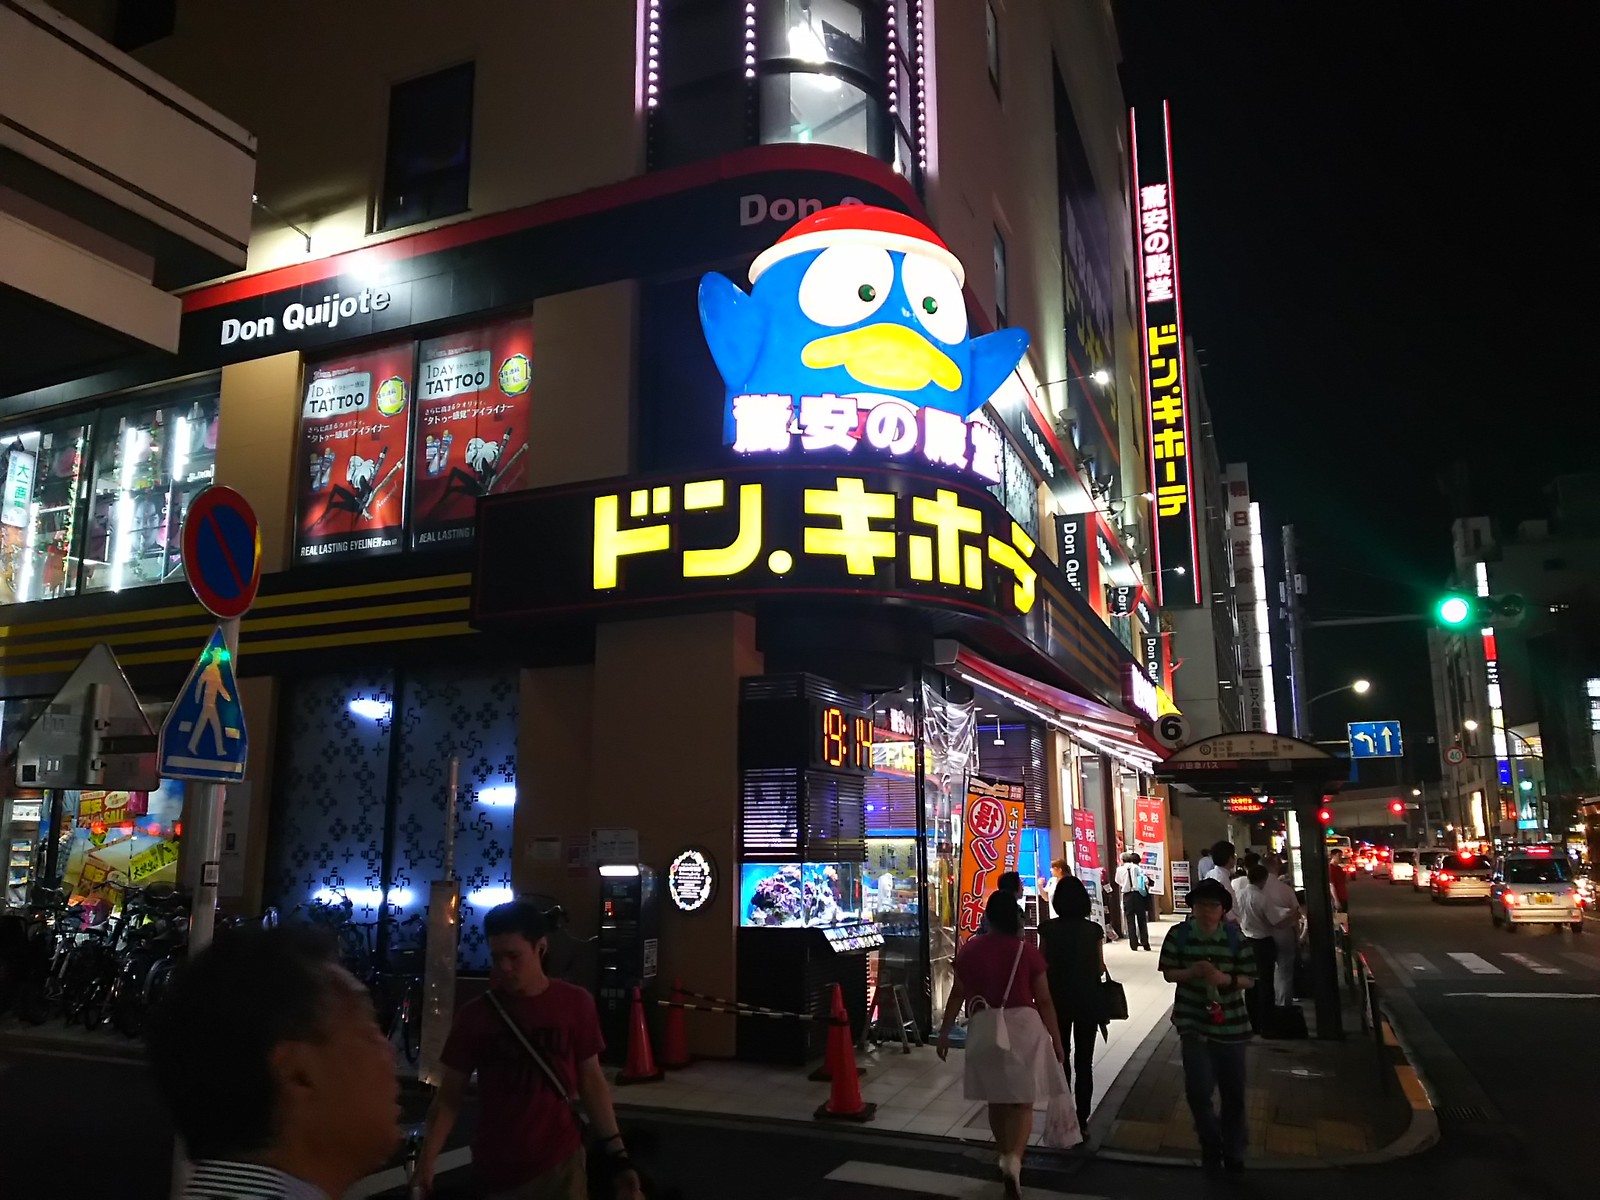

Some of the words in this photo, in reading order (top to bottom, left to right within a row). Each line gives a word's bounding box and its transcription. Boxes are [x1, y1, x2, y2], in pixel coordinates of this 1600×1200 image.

[740, 194, 822, 226] Don
[1140, 183, 1174, 302] 驚安の殿堂
[221, 317, 275, 345] Don
[283, 288, 391, 330] Quijote
[426, 371, 485, 395] TATTOO
[309, 392, 364, 413] TATTOO
[437, 527, 471, 541] LASTING
[1063, 522, 1078, 555] Don
[301, 545, 319, 556] REAL
[319, 541, 348, 555] LASTING
[350, 537, 382, 550] EYELINER
[1147, 638, 1157, 659] Don
[823, 708, 874, 769] 19:14
[1160, 716, 1183, 740] 6
[1177, 761, 1219, 770] 小田急バス
[1138, 811, 1159, 824] 免税
[1143, 824, 1154, 832] Tax
[1075, 826, 1096, 843] 免税
[1078, 852, 1092, 862] Free
